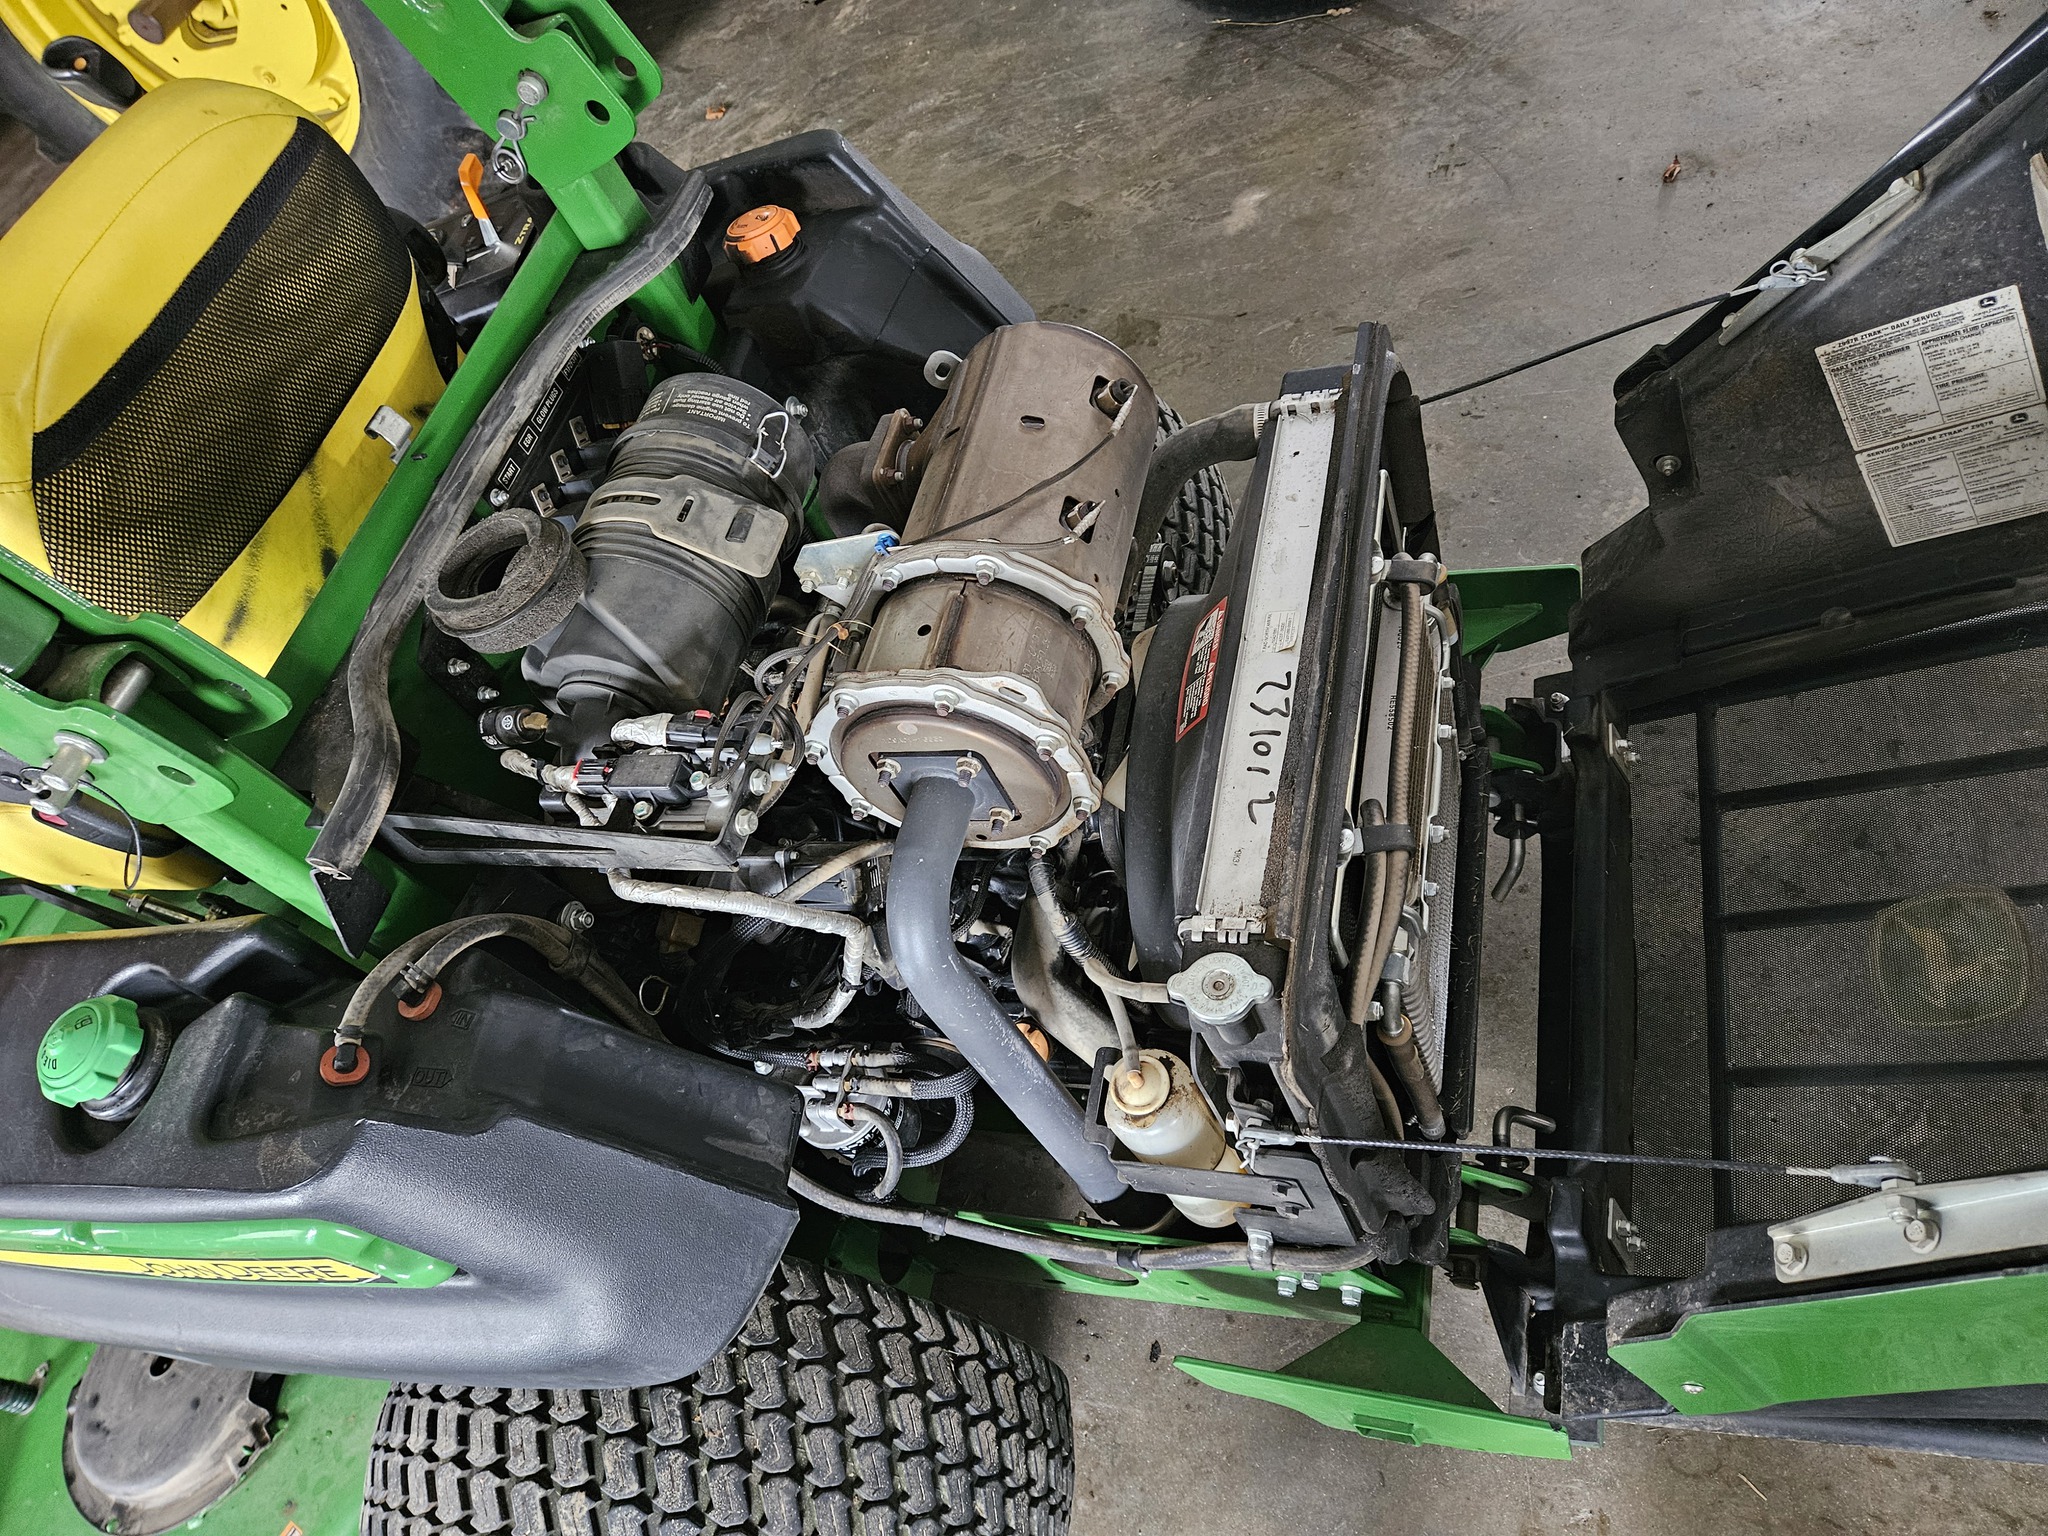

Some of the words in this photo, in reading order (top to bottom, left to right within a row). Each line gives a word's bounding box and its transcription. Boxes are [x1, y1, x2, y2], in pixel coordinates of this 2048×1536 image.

[1890, 320, 1910, 330] DAILY
[1912, 310, 1942, 323] SERVICE
[536, 407, 550, 425] GLOW
[546, 387, 559, 410] PLUGS
[696, 404, 718, 413] engine
[724, 406, 736, 414] not
[687, 409, 726, 422] IMPORTANT
[718, 410, 743, 424] prevent
[735, 411, 745, 419] Do
[742, 421, 751, 429] To
[522, 433, 534, 448] EGR
[1866, 445, 1899, 457] SERVICIO
[502, 464, 516, 485] START
[1211, 618, 1222, 652] DANGER
[1202, 671, 1213, 707] PELIGRO
[415, 1070, 446, 1086] OUT
[129, 1258, 216, 1278] JOHN
[212, 1262, 350, 1279] DEERE
